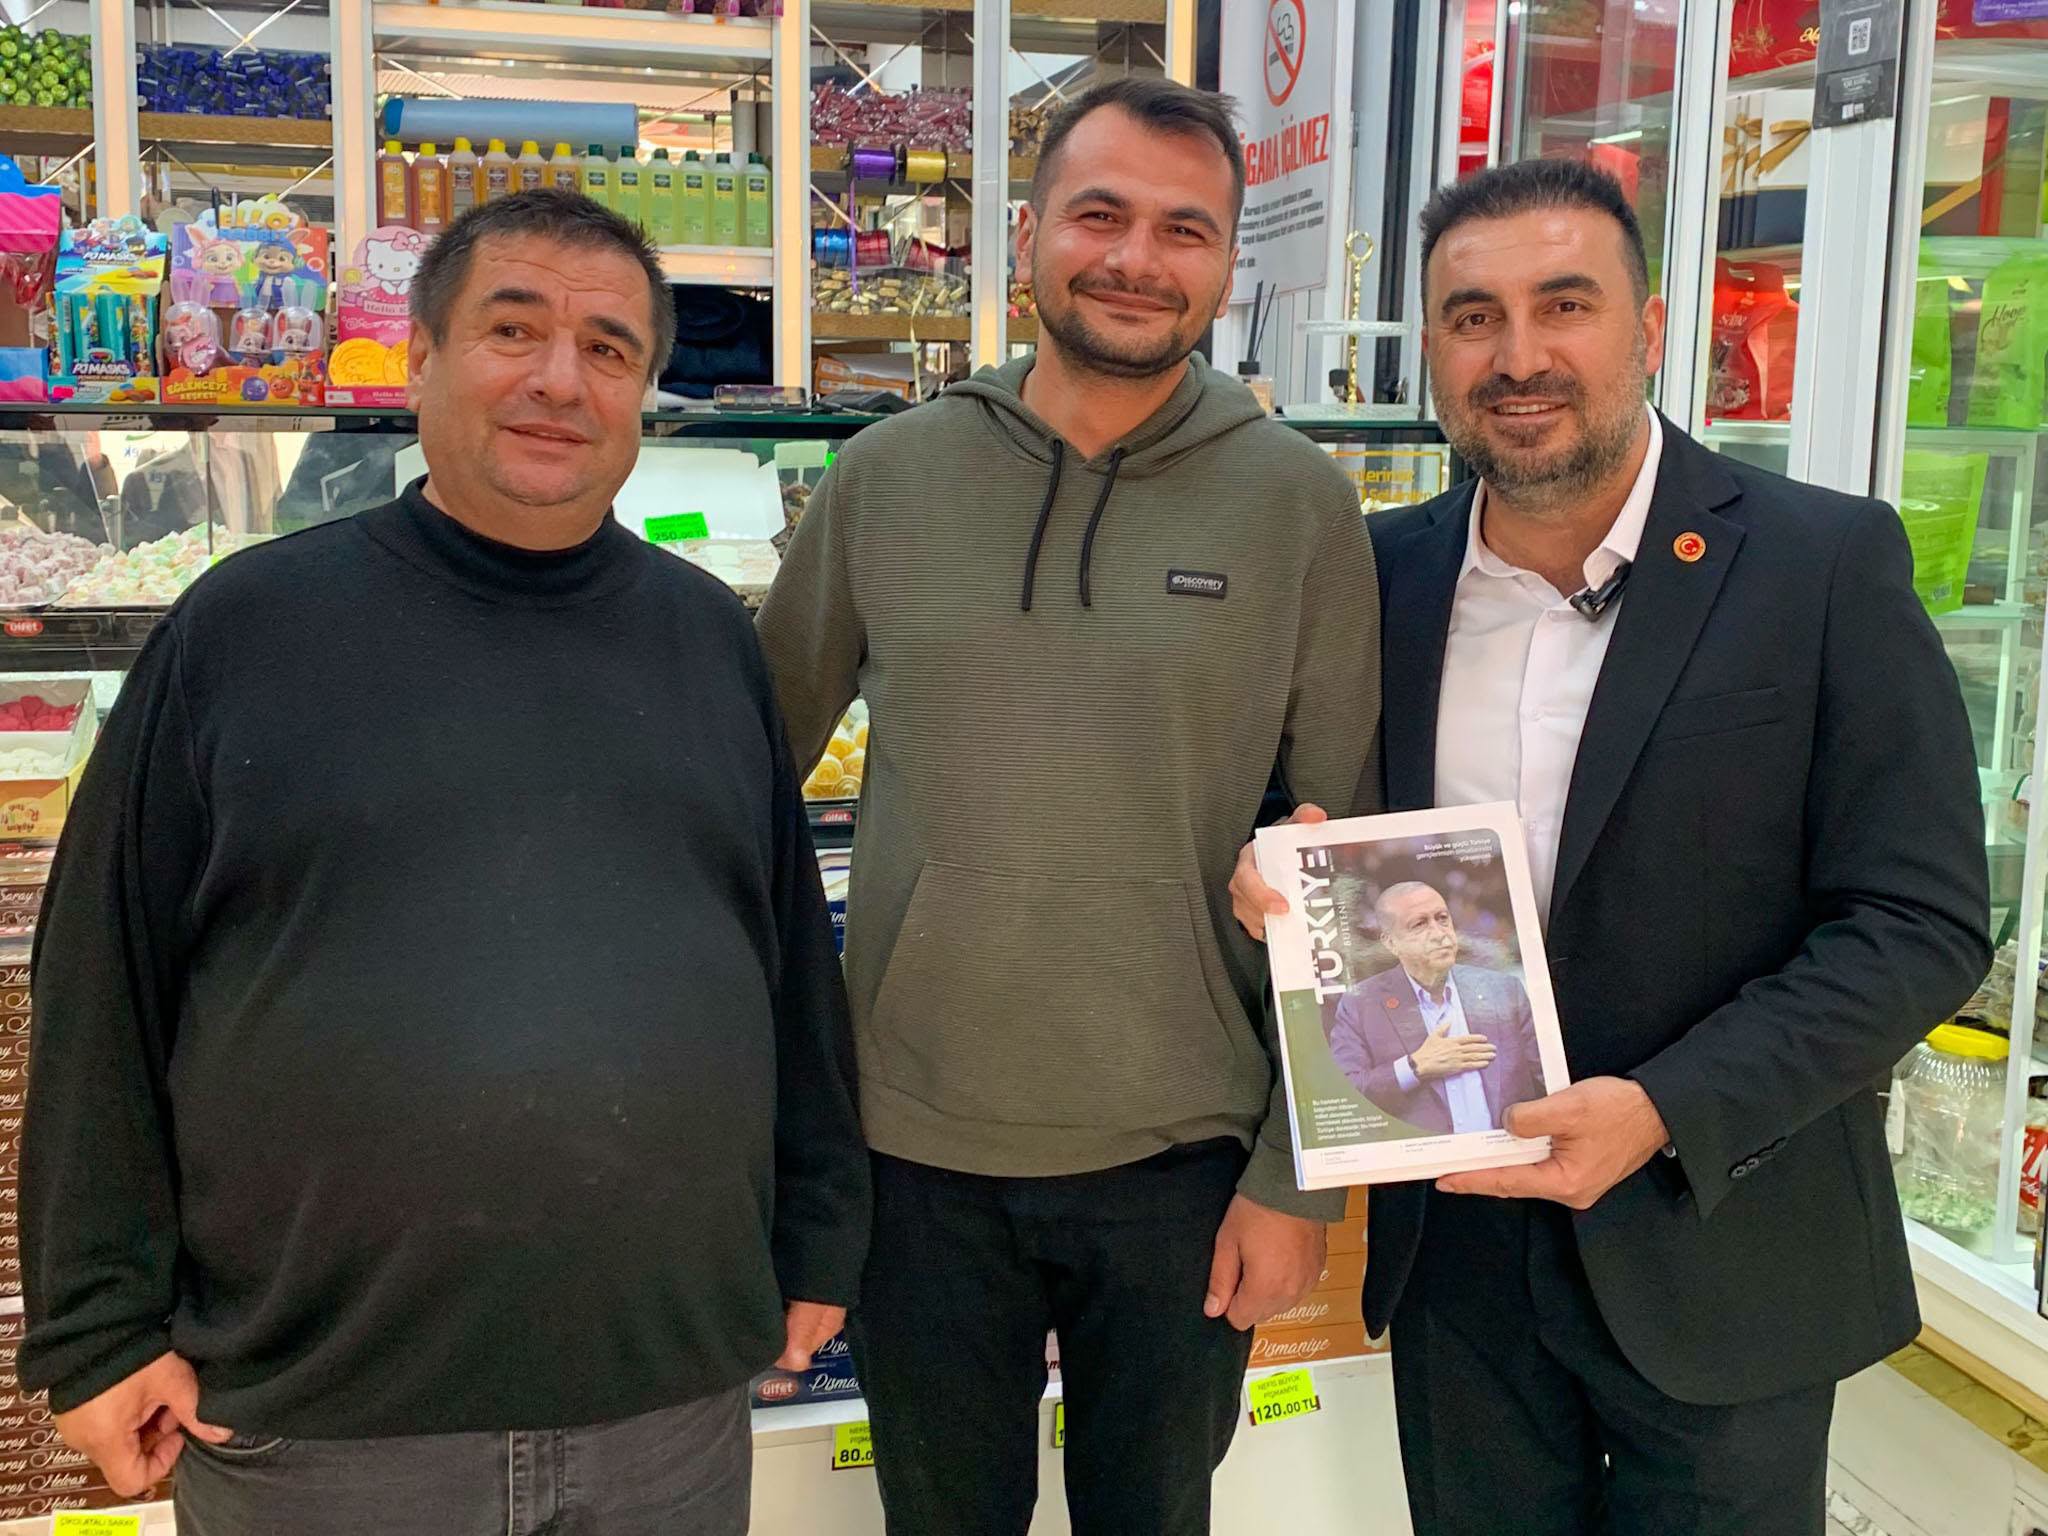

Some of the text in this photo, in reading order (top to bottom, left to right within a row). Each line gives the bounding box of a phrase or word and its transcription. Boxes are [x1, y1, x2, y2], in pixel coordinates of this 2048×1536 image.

[1241, 113, 1329, 186] GARA İÇİLMEZ
[15, 911, 39, 924] Sara
[1298, 848, 1347, 1005] TÜRKİYE
[1336, 899, 1352, 947] BÜLTENİ
[1274, 1302, 1330, 1324] maniye
[763, 1381, 793, 1396] ülfet
[1256, 1397, 1317, 1422] 120.00 TL
[840, 1448, 874, 1463] 80.0
